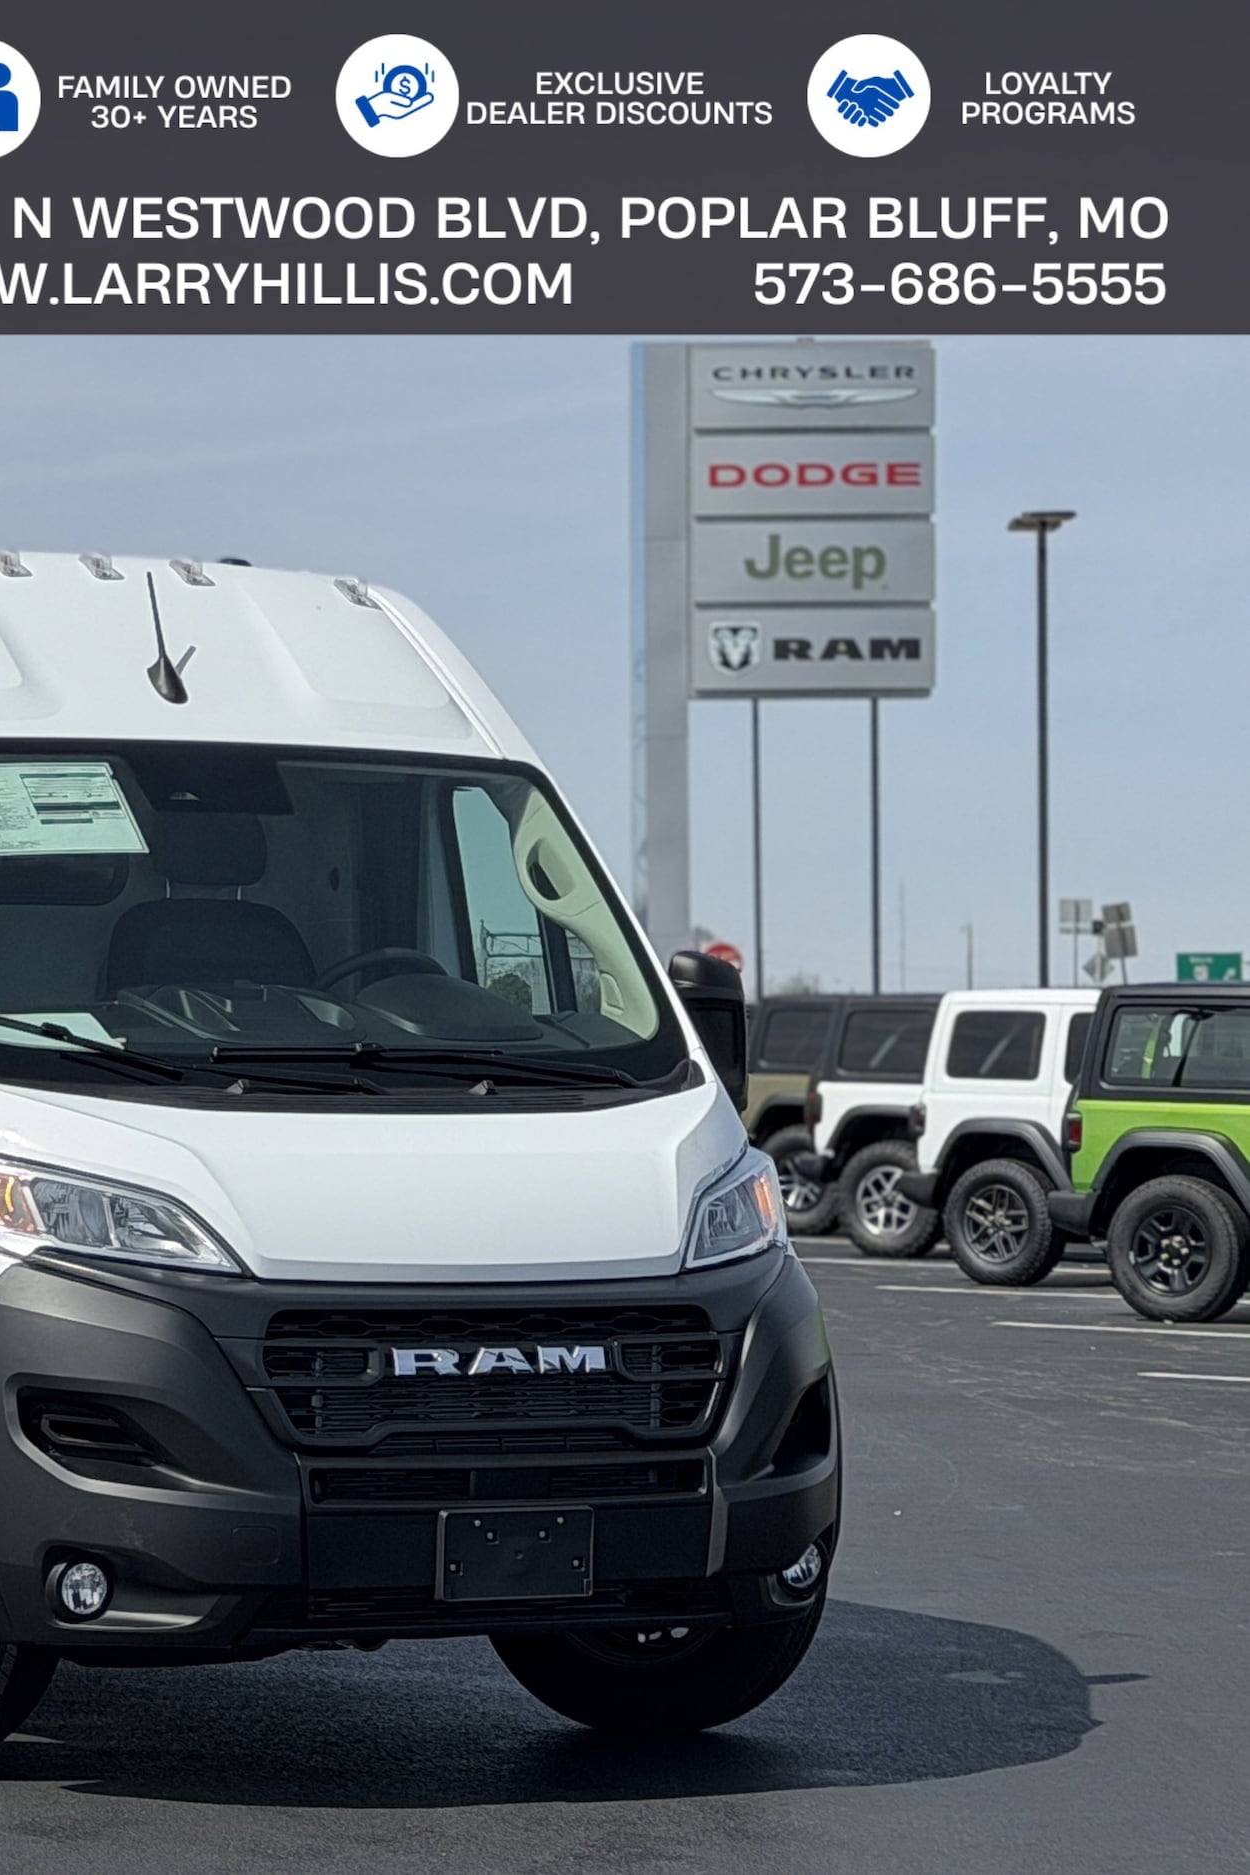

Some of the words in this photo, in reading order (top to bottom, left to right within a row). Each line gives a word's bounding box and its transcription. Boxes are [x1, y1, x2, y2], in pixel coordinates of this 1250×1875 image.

[712, 365, 916, 382] CHRYSLER
[708, 462, 922, 489] DODGE
[744, 533, 887, 590] Jeep
[772, 637, 922, 662] RAM
[391, 1345, 606, 1377] RAM
